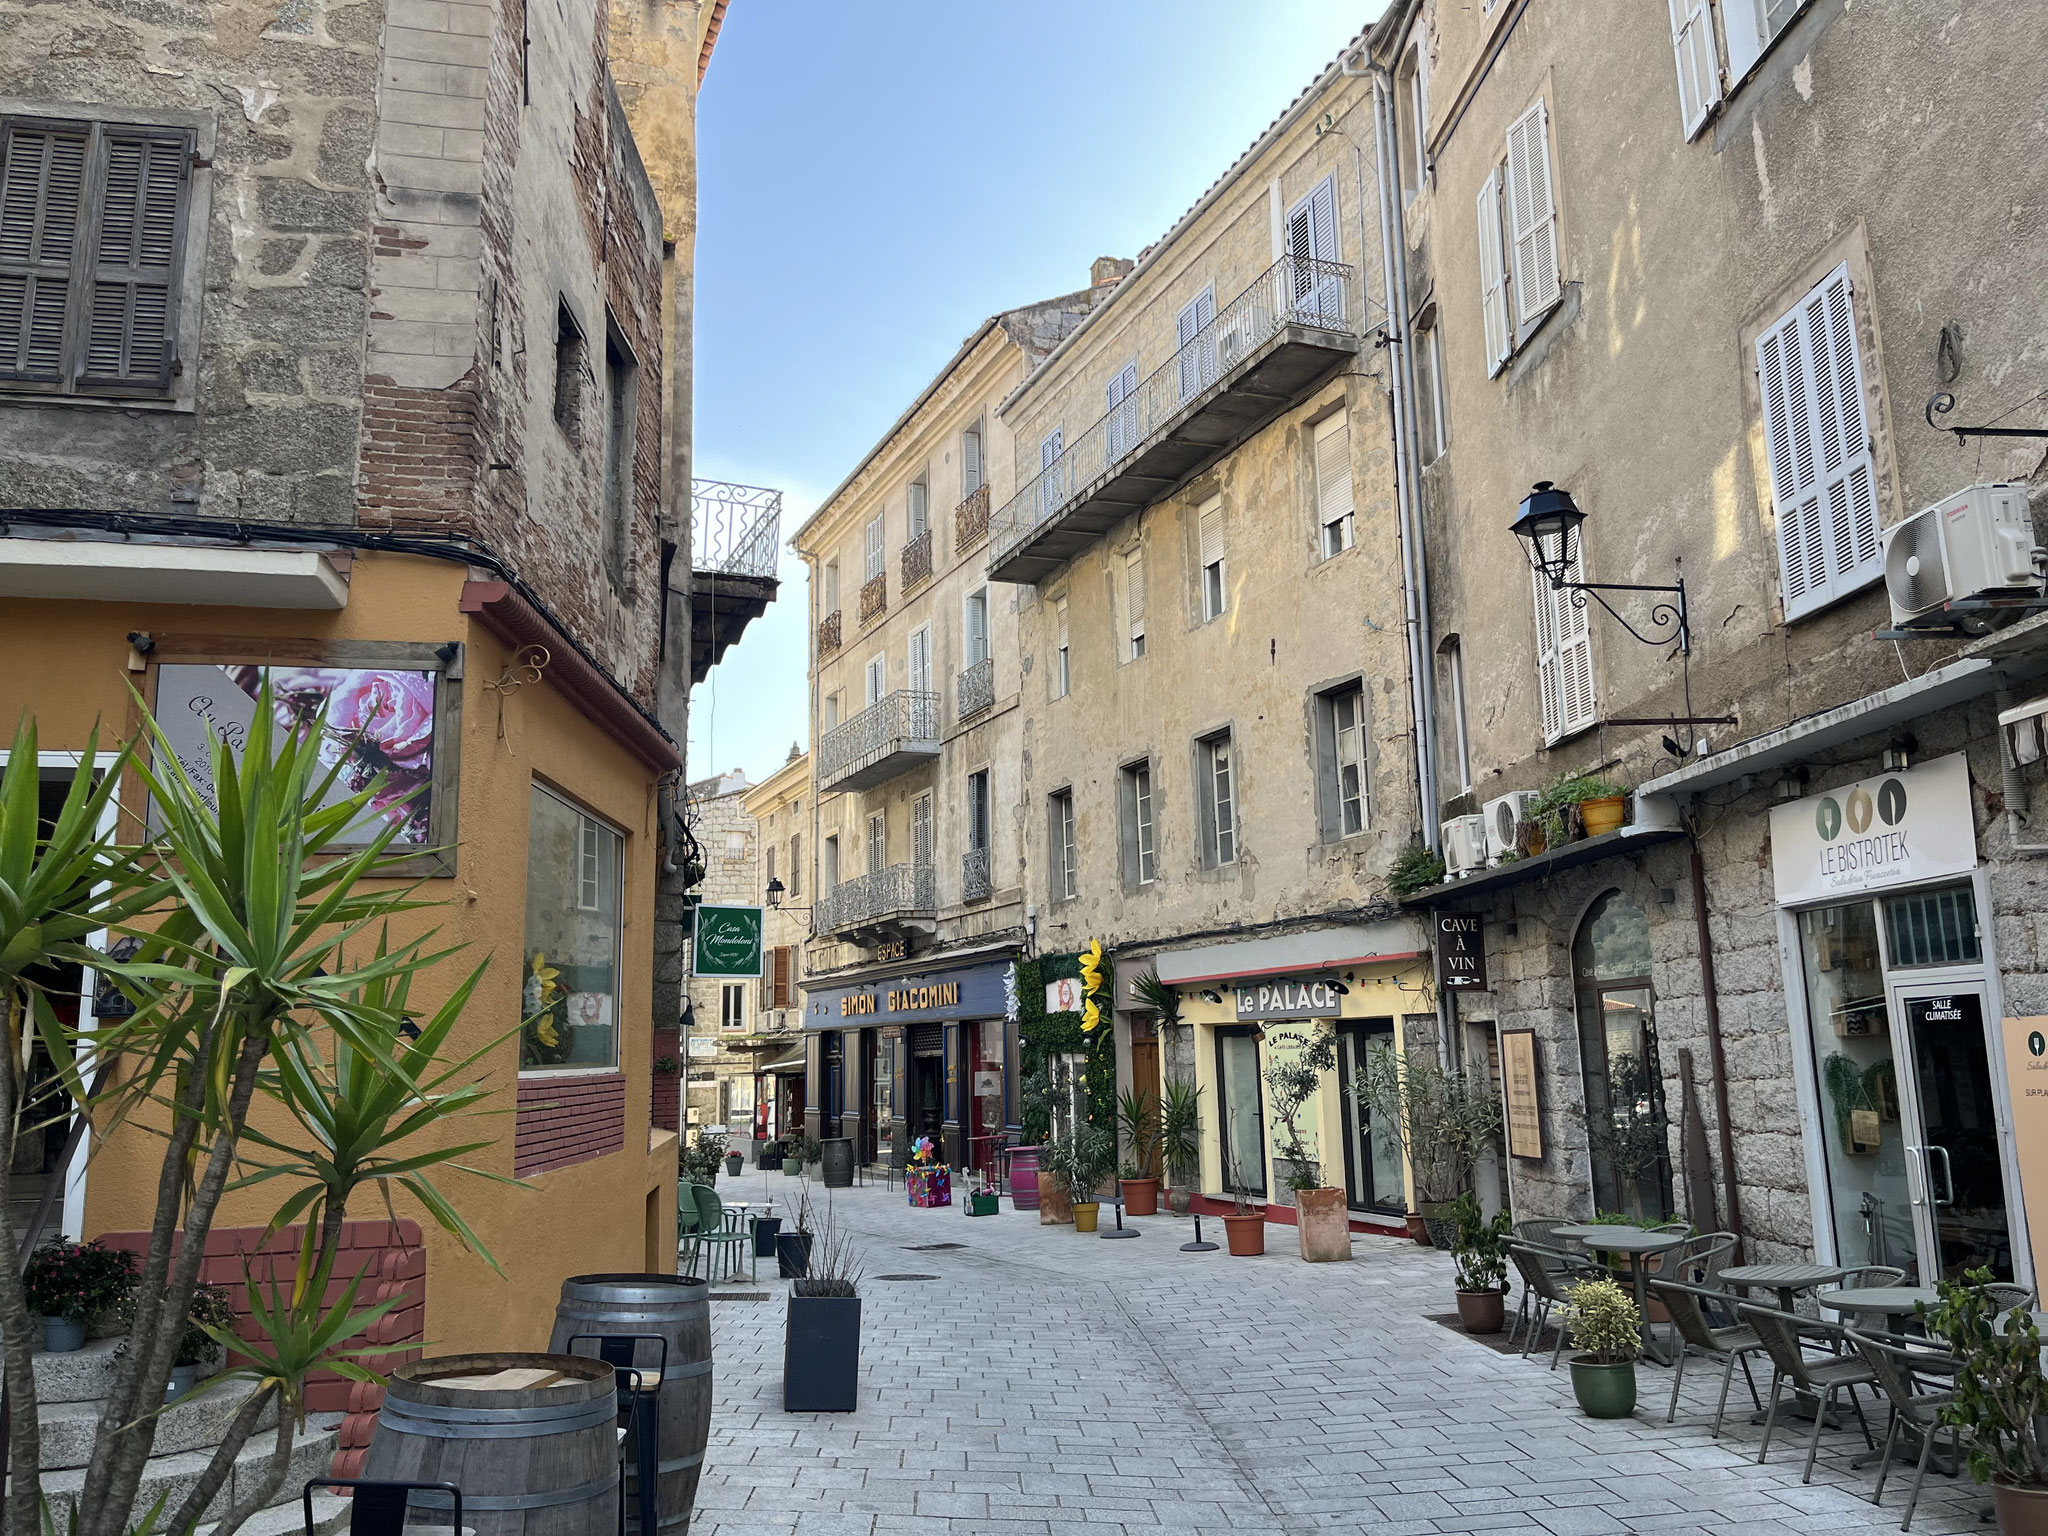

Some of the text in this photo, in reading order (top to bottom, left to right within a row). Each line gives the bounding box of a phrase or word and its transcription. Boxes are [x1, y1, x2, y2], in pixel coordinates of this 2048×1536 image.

[1820, 830, 1910, 876] LE BISTROTEK
[719, 922, 740, 933] Casa
[1441, 919, 1477, 932] CAVE
[706, 934, 753, 946] Mondoloni
[1456, 935, 1466, 950] À
[878, 940, 905, 961] ESPACE
[1448, 957, 1475, 970] VIN
[841, 981, 958, 1016] SIMON GIACOMINI
[1237, 982, 1336, 1013] Le PALACE
[1932, 1000, 1951, 1010] SALLE
[1925, 1009, 1961, 1021] CLIMATISÉE
[1269, 1032, 1310, 1047] LE PALACE
